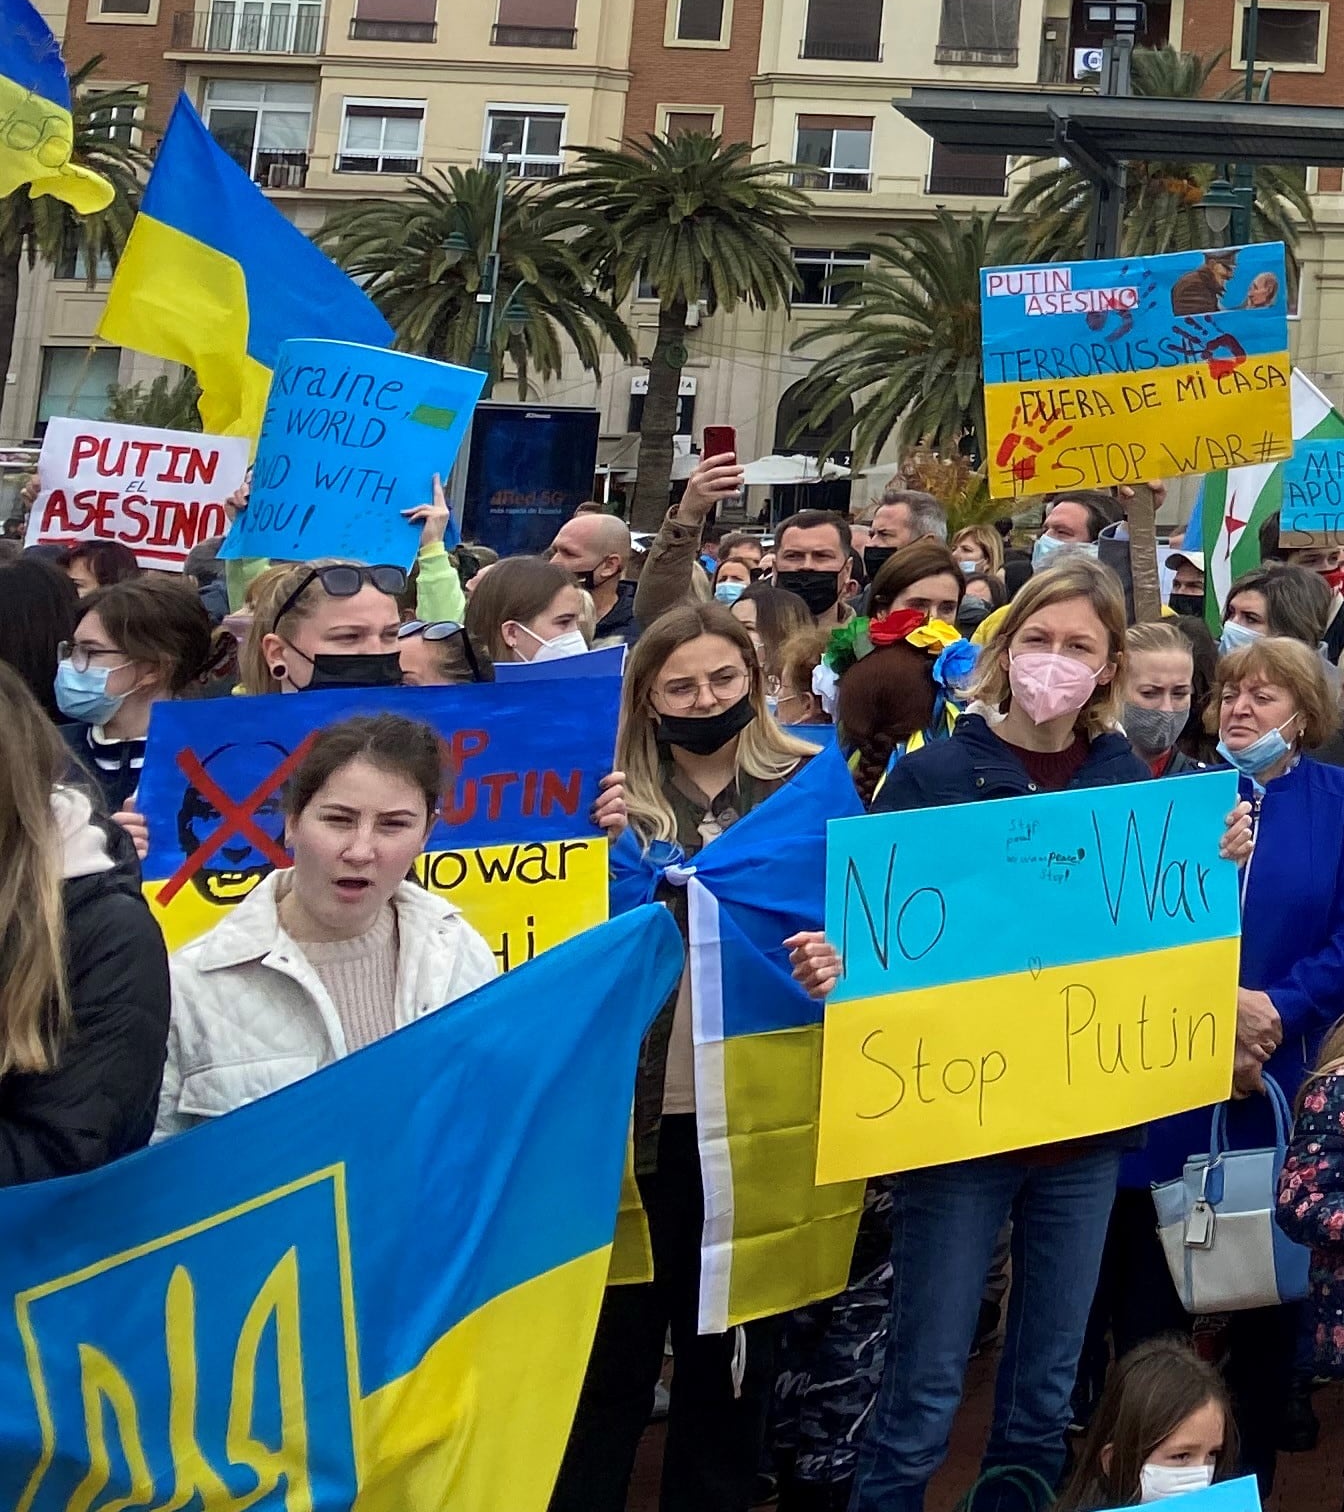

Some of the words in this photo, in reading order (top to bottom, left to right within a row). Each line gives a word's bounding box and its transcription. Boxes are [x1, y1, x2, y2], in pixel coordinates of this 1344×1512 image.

[989, 269, 1070, 296] PUTIN
[1025, 289, 1138, 316] ASESINO
[1019, 385, 1114, 425] FUERA
[1121, 383, 1162, 413] DE
[1216, 365, 1288, 396] CASA
[286, 408, 386, 448] WORLD
[67, 435, 219, 485] PUTIN
[314, 460, 397, 505] WITH
[1053, 442, 1148, 489] STOP
[1160, 433, 1252, 474] WAR
[125, 480, 148, 493] EL
[39, 489, 227, 549] ASESINO
[443, 769, 583, 826] UTIN
[474, 841, 589, 886] war
[842, 841, 947, 980] No
[1091, 799, 1211, 926] War
[855, 1029, 1007, 1127] Stop
[1060, 983, 1217, 1086] Putin
